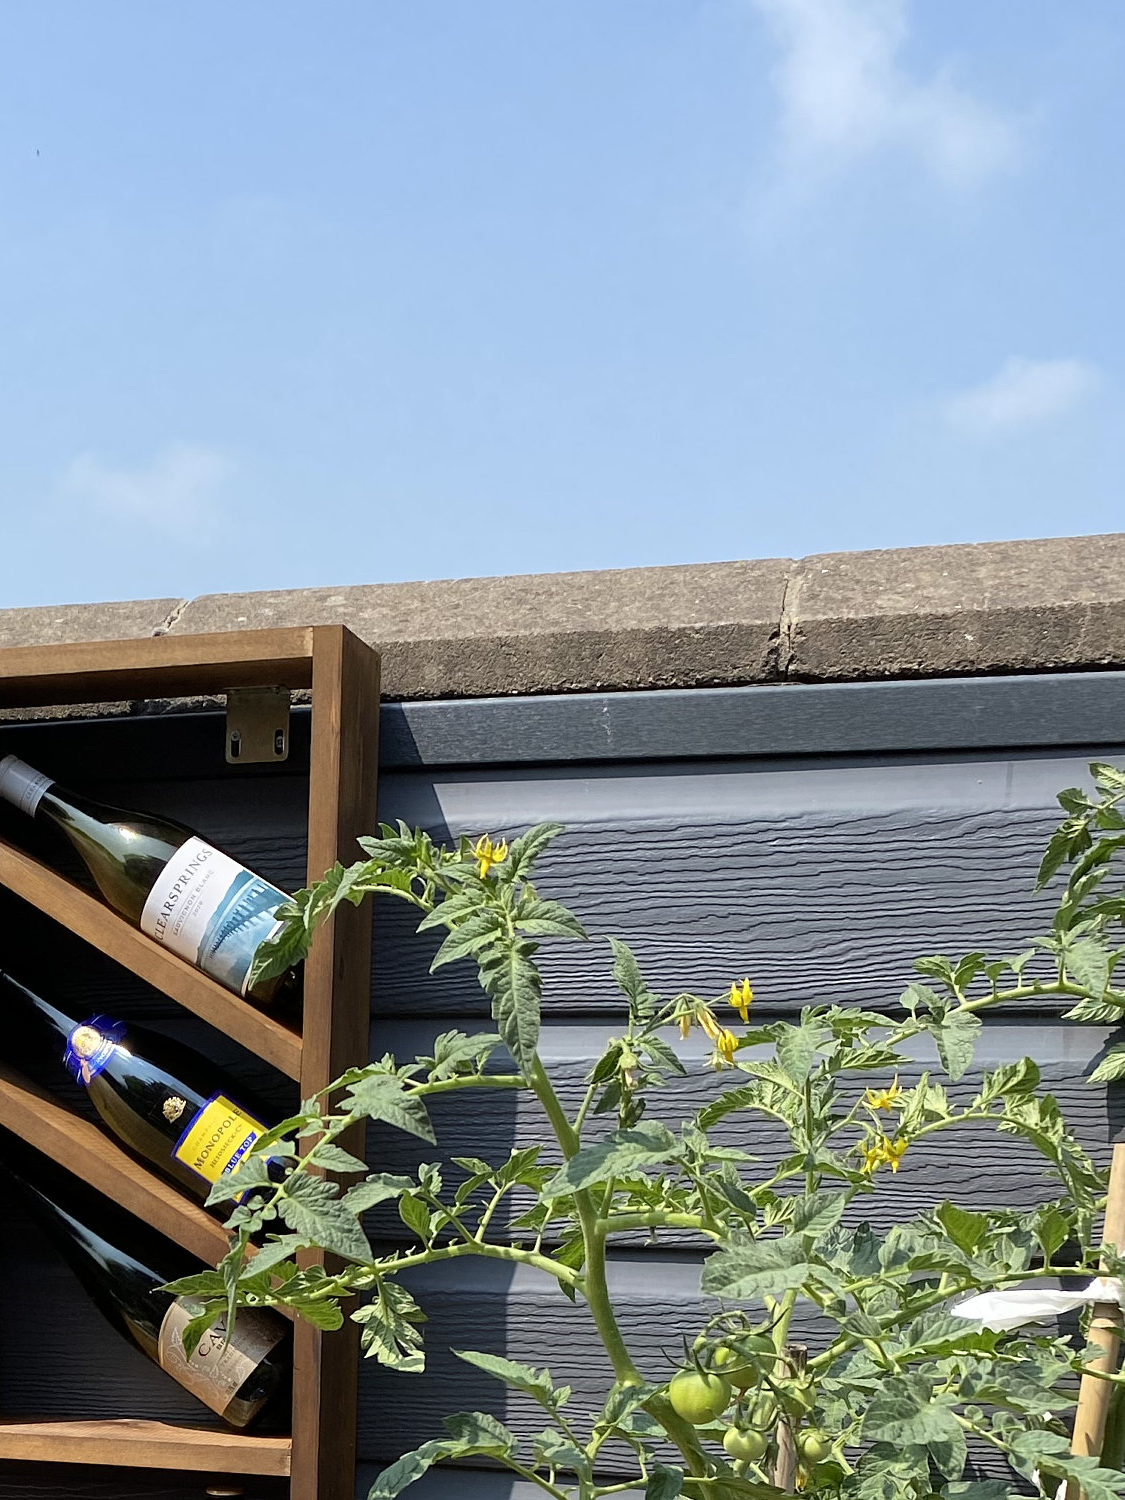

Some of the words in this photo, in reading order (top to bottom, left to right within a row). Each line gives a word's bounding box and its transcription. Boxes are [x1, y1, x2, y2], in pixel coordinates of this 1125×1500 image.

[154, 848, 213, 941] CLEARSPRINGS
[193, 1108, 242, 1170] MONOPOLE
[224, 1151, 242, 1175] BLUE
[240, 1136, 254, 1152] TOP
[198, 1319, 228, 1357] CAV
